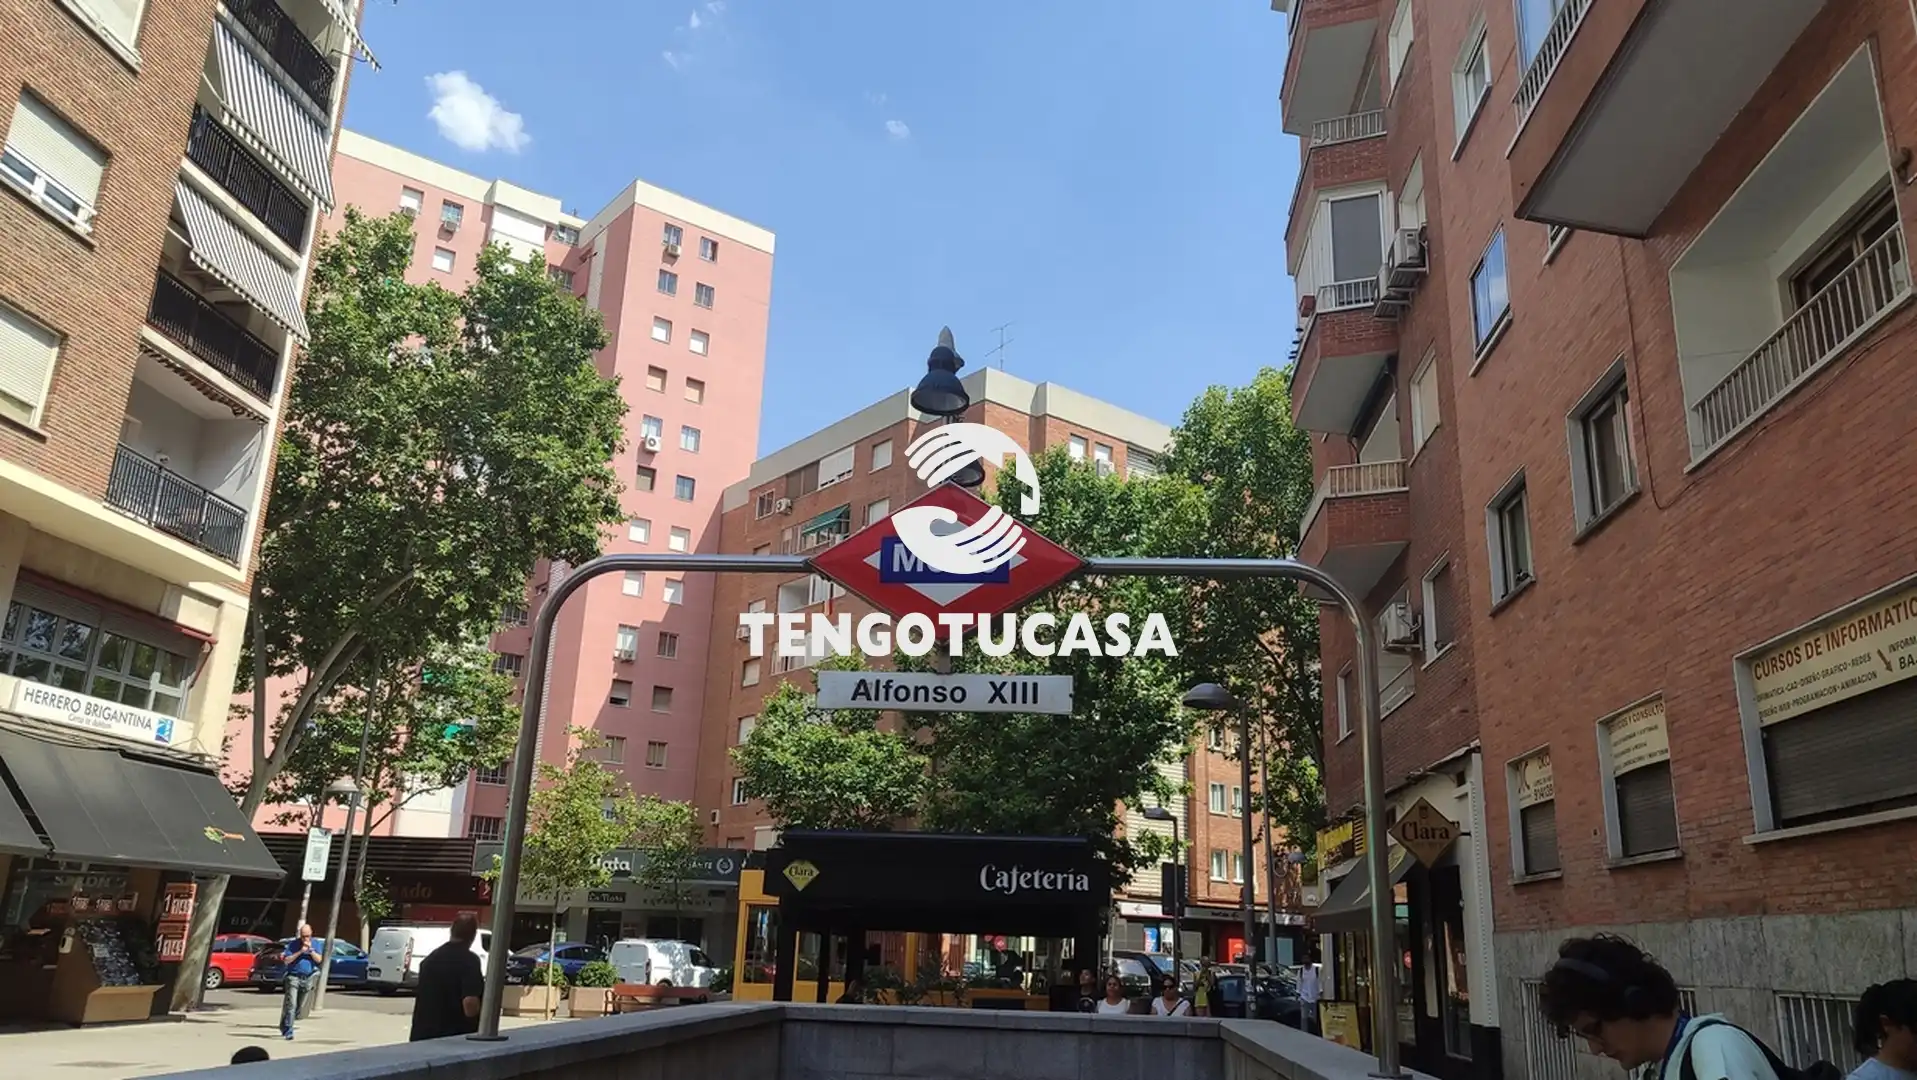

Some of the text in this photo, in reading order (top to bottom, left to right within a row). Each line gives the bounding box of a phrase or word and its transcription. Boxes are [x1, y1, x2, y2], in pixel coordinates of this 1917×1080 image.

[1888, 635, 1917, 654] INFORM
[1754, 646, 1802, 681] CURSOS
[1804, 637, 1823, 660] DE
[1899, 653, 1917, 670] BA
[851, 677, 1039, 705] Alfonso XIII
[24, 687, 82, 713] HERRERO
[84, 701, 152, 731] BRIGANTINA
[1401, 820, 1450, 842] Clara
[788, 865, 814, 877] Clara
[979, 863, 1089, 895] Cafetería
